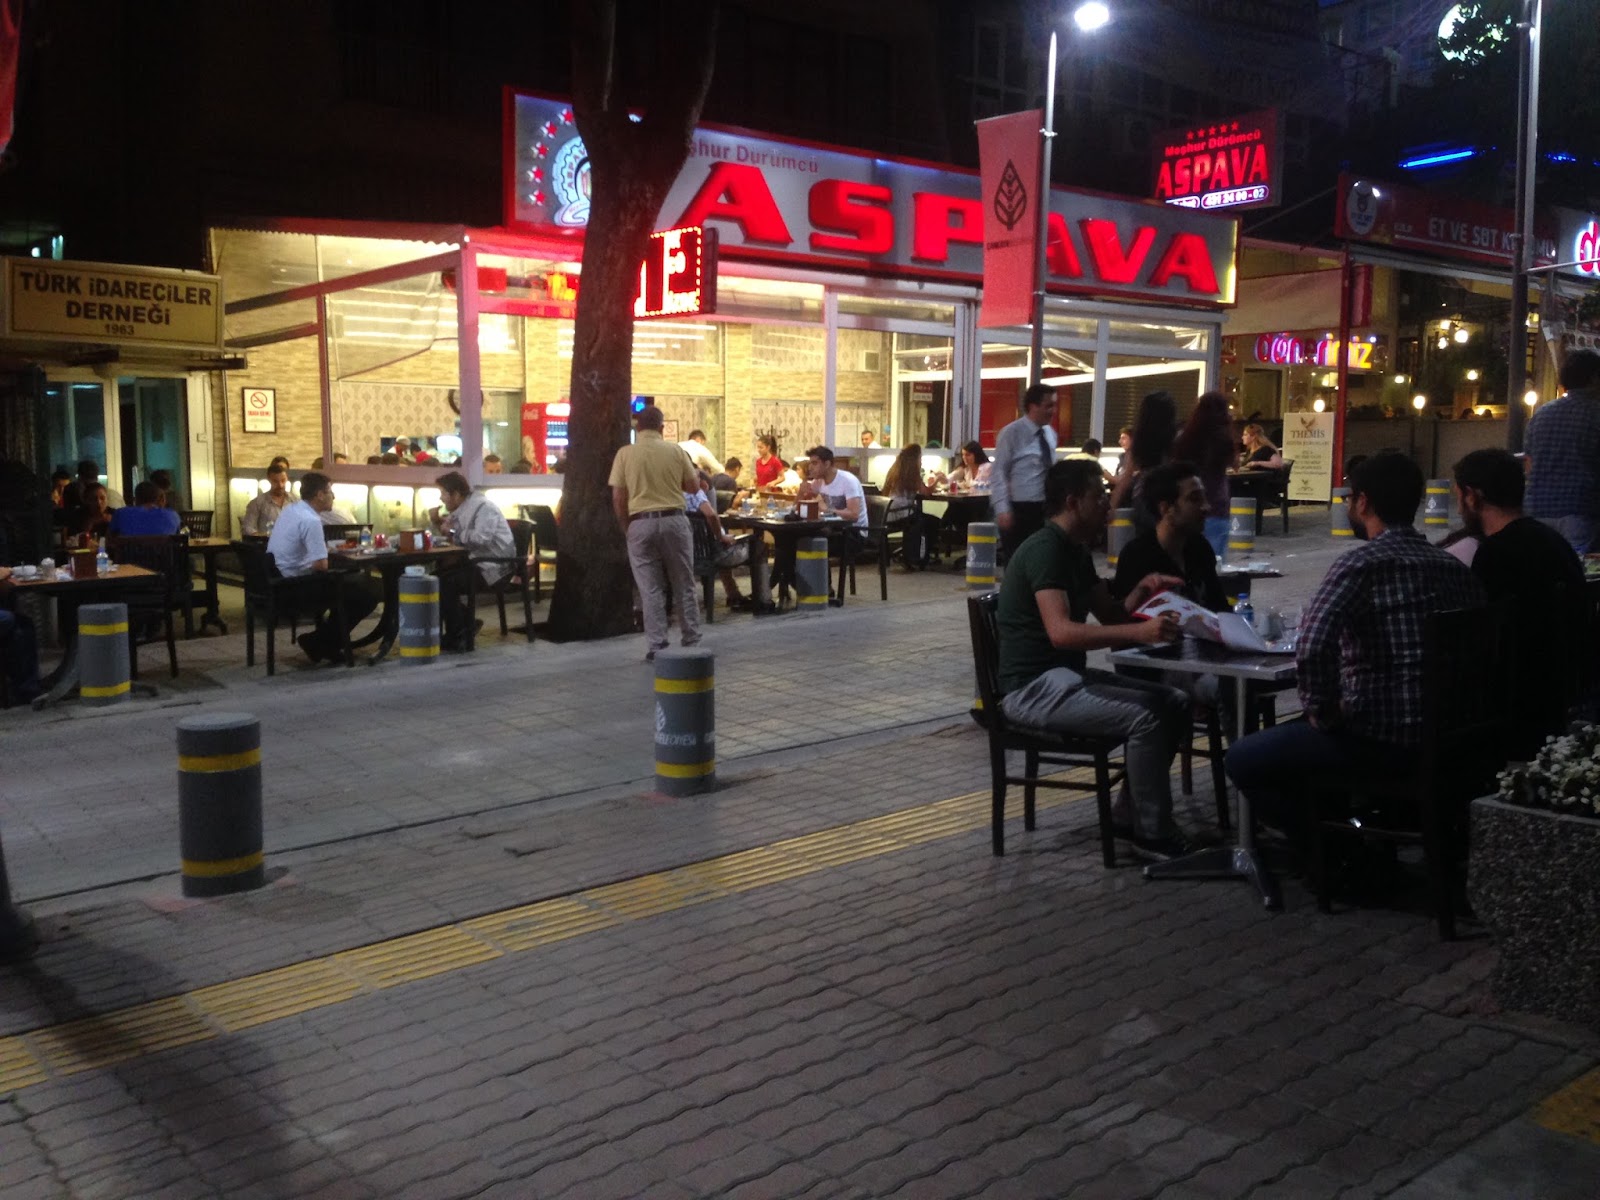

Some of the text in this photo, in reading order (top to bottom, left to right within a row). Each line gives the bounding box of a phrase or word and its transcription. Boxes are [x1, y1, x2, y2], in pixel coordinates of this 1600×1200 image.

[1155, 144, 1269, 198] ASPAVA
[1428, 216, 1447, 239] ET
[1449, 221, 1469, 244] VE
[20, 269, 82, 295] TÜRK
[104, 323, 135, 336] 1963
